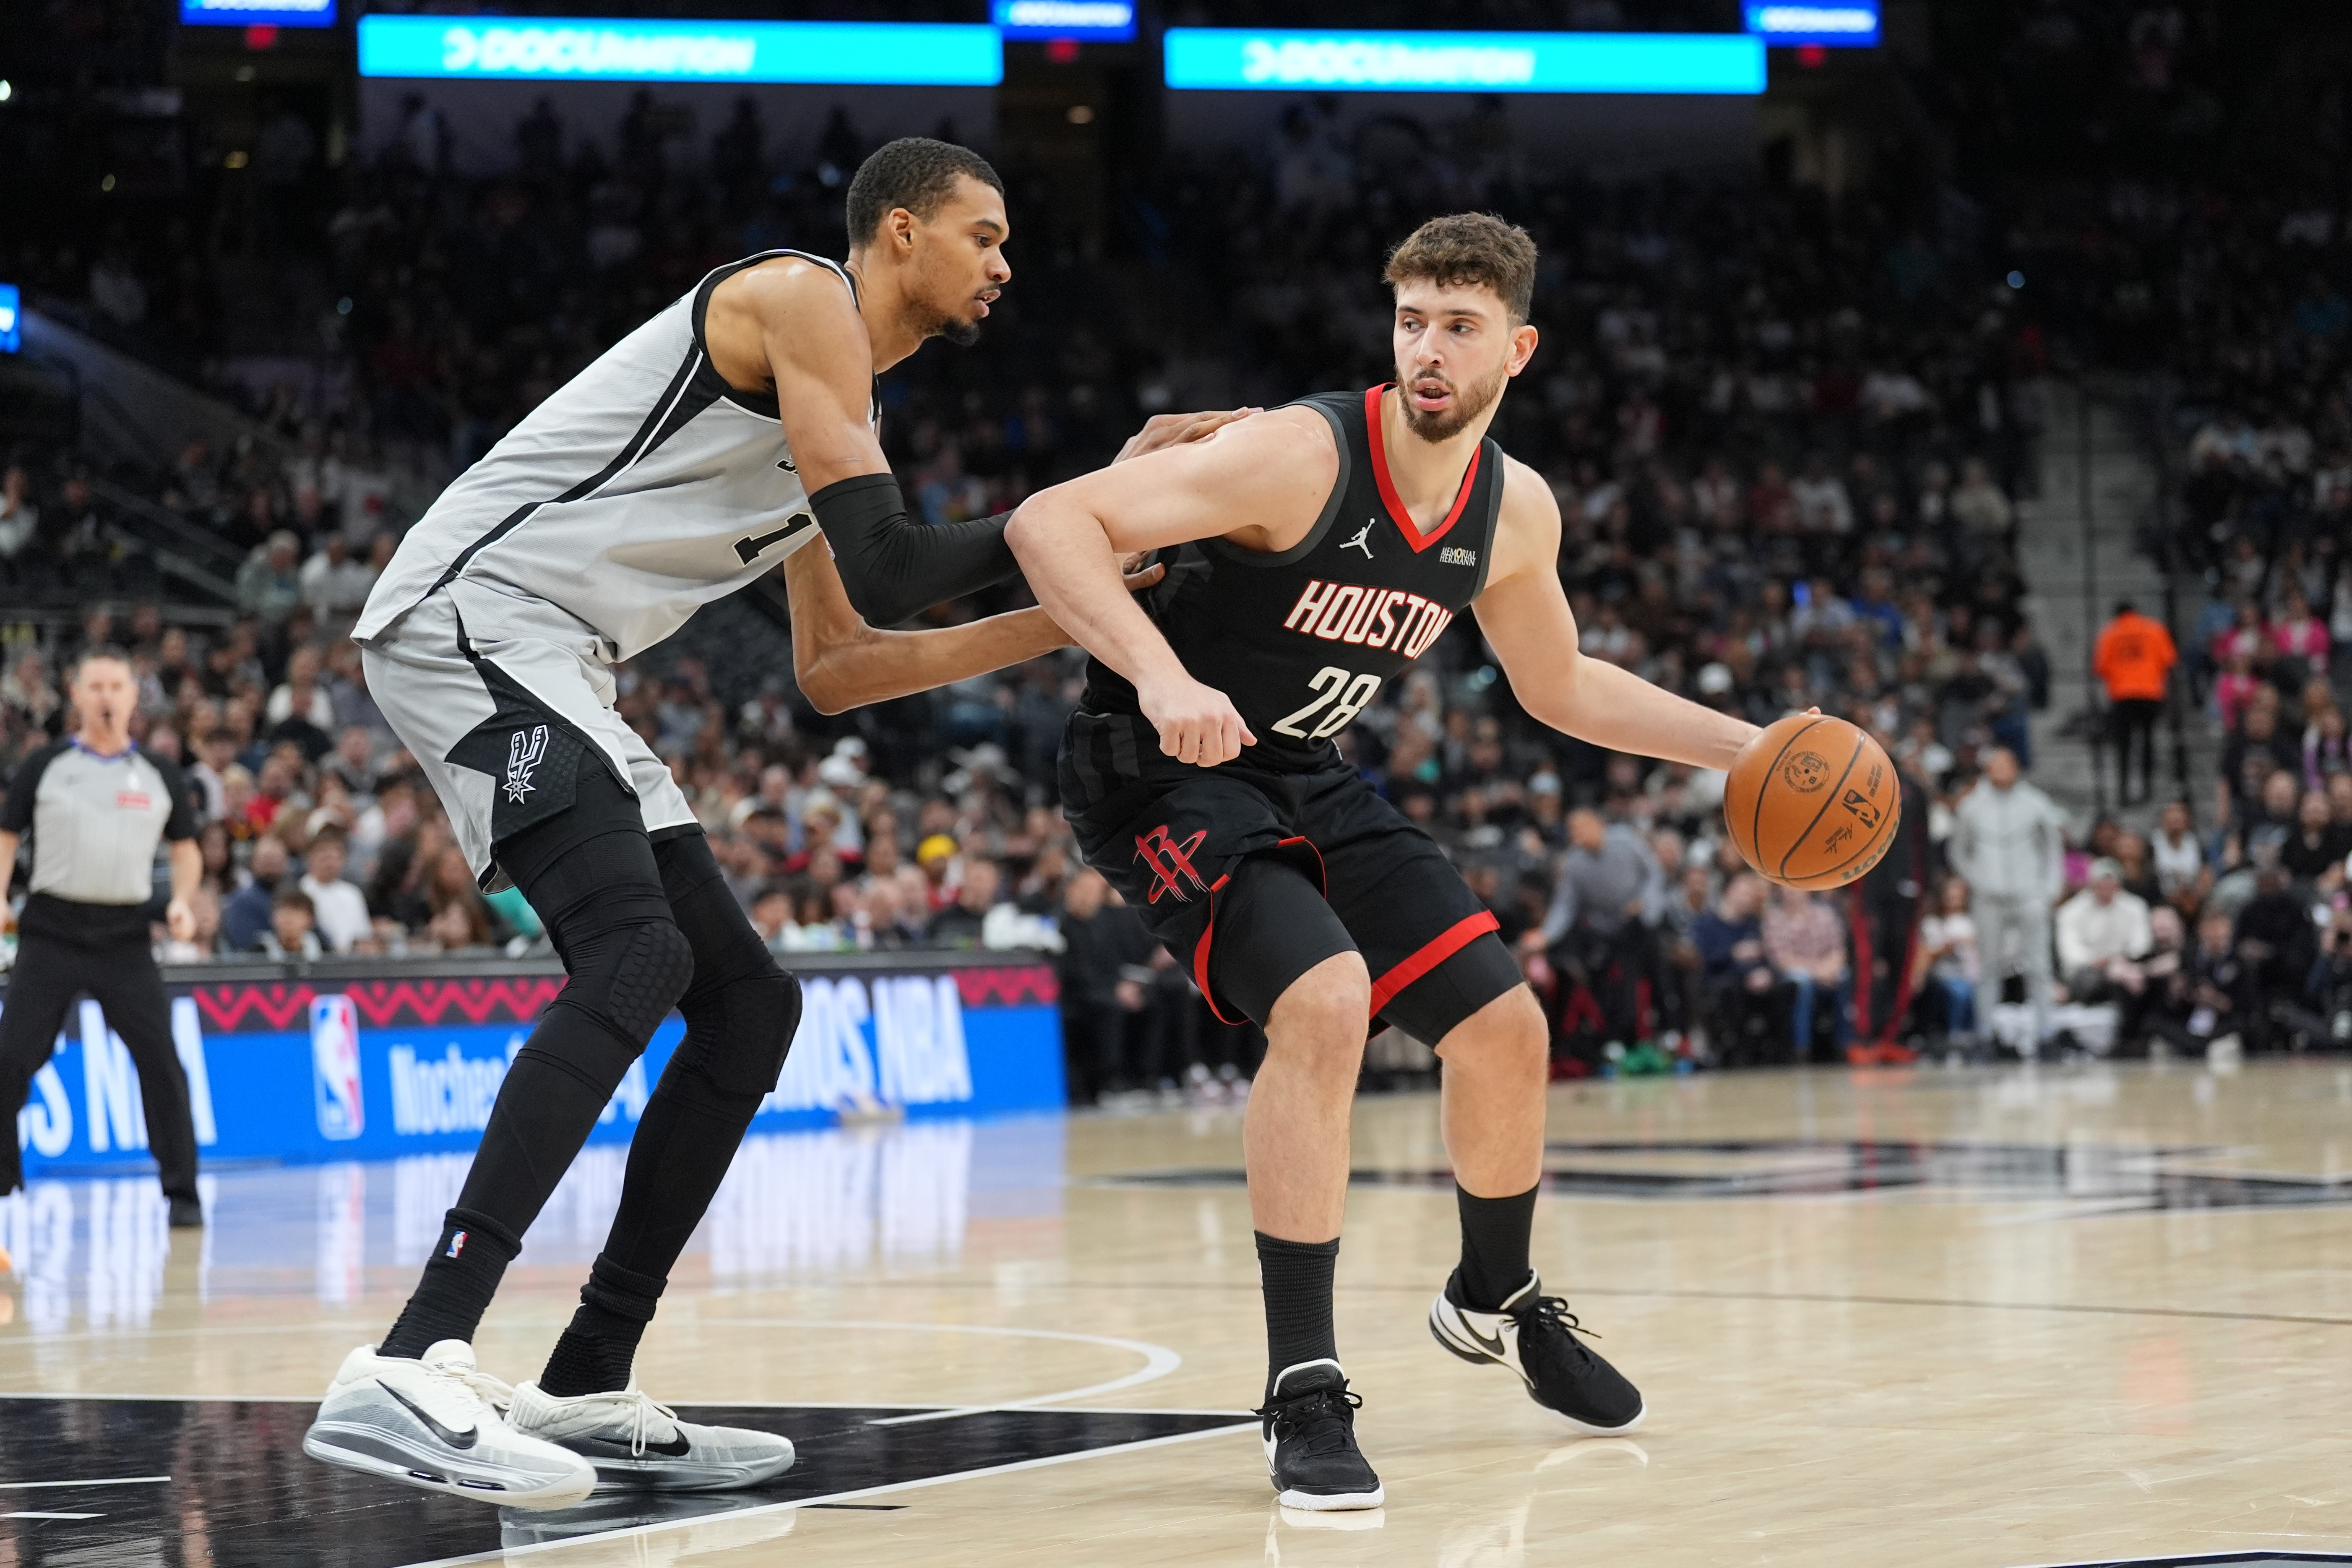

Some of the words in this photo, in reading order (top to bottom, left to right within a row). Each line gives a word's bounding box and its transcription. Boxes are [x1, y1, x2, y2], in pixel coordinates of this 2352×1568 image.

[731, 511, 814, 568] 1
[1439, 554, 1476, 567] HERMANN
[1441, 547, 1476, 560] MEMORIAL
[1282, 579, 1454, 660] HOUSTON
[1271, 666, 1381, 740] 28
